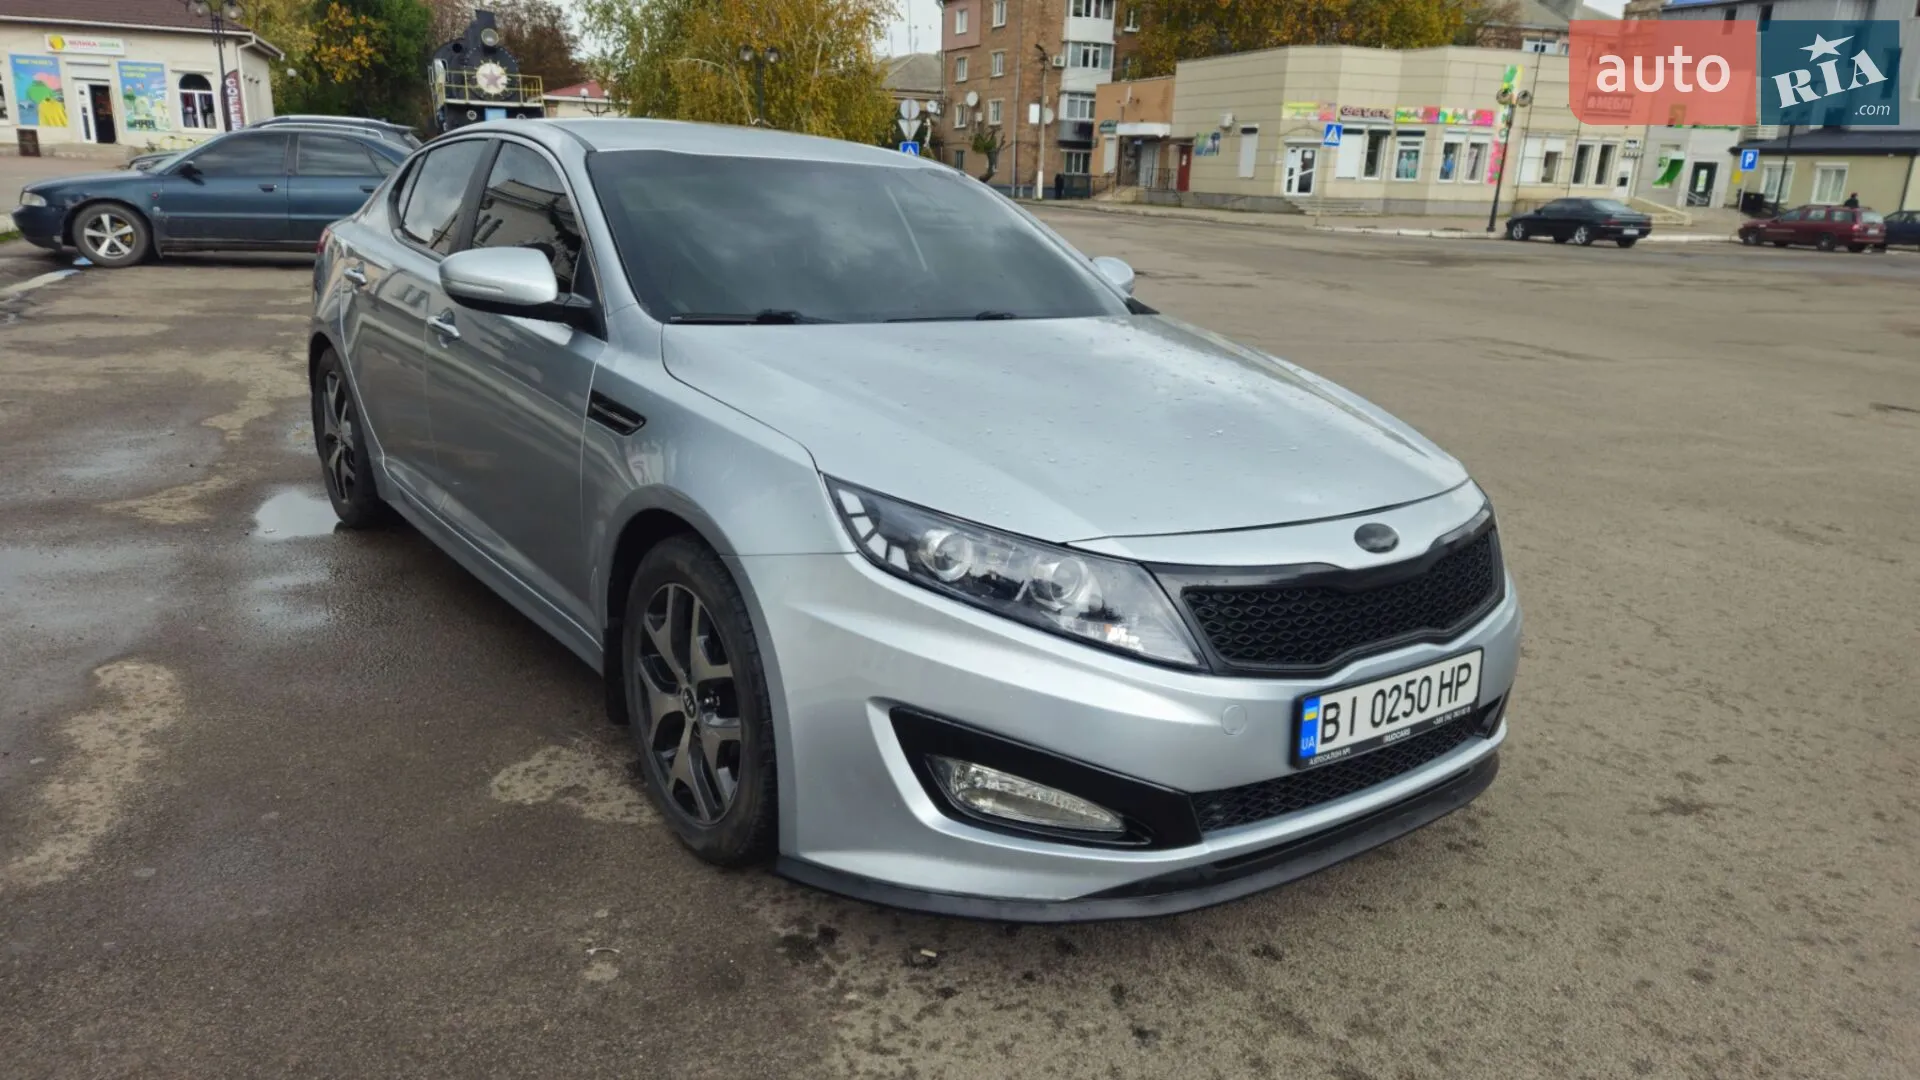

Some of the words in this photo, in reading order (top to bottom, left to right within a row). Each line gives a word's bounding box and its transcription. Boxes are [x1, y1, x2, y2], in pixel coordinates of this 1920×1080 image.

[1745, 152, 1754, 167] P
[1320, 696, 1357, 746] BI
[1370, 675, 1432, 729] 0250
[1437, 662, 1472, 708] HP
[1300, 736, 1316, 751] UA
